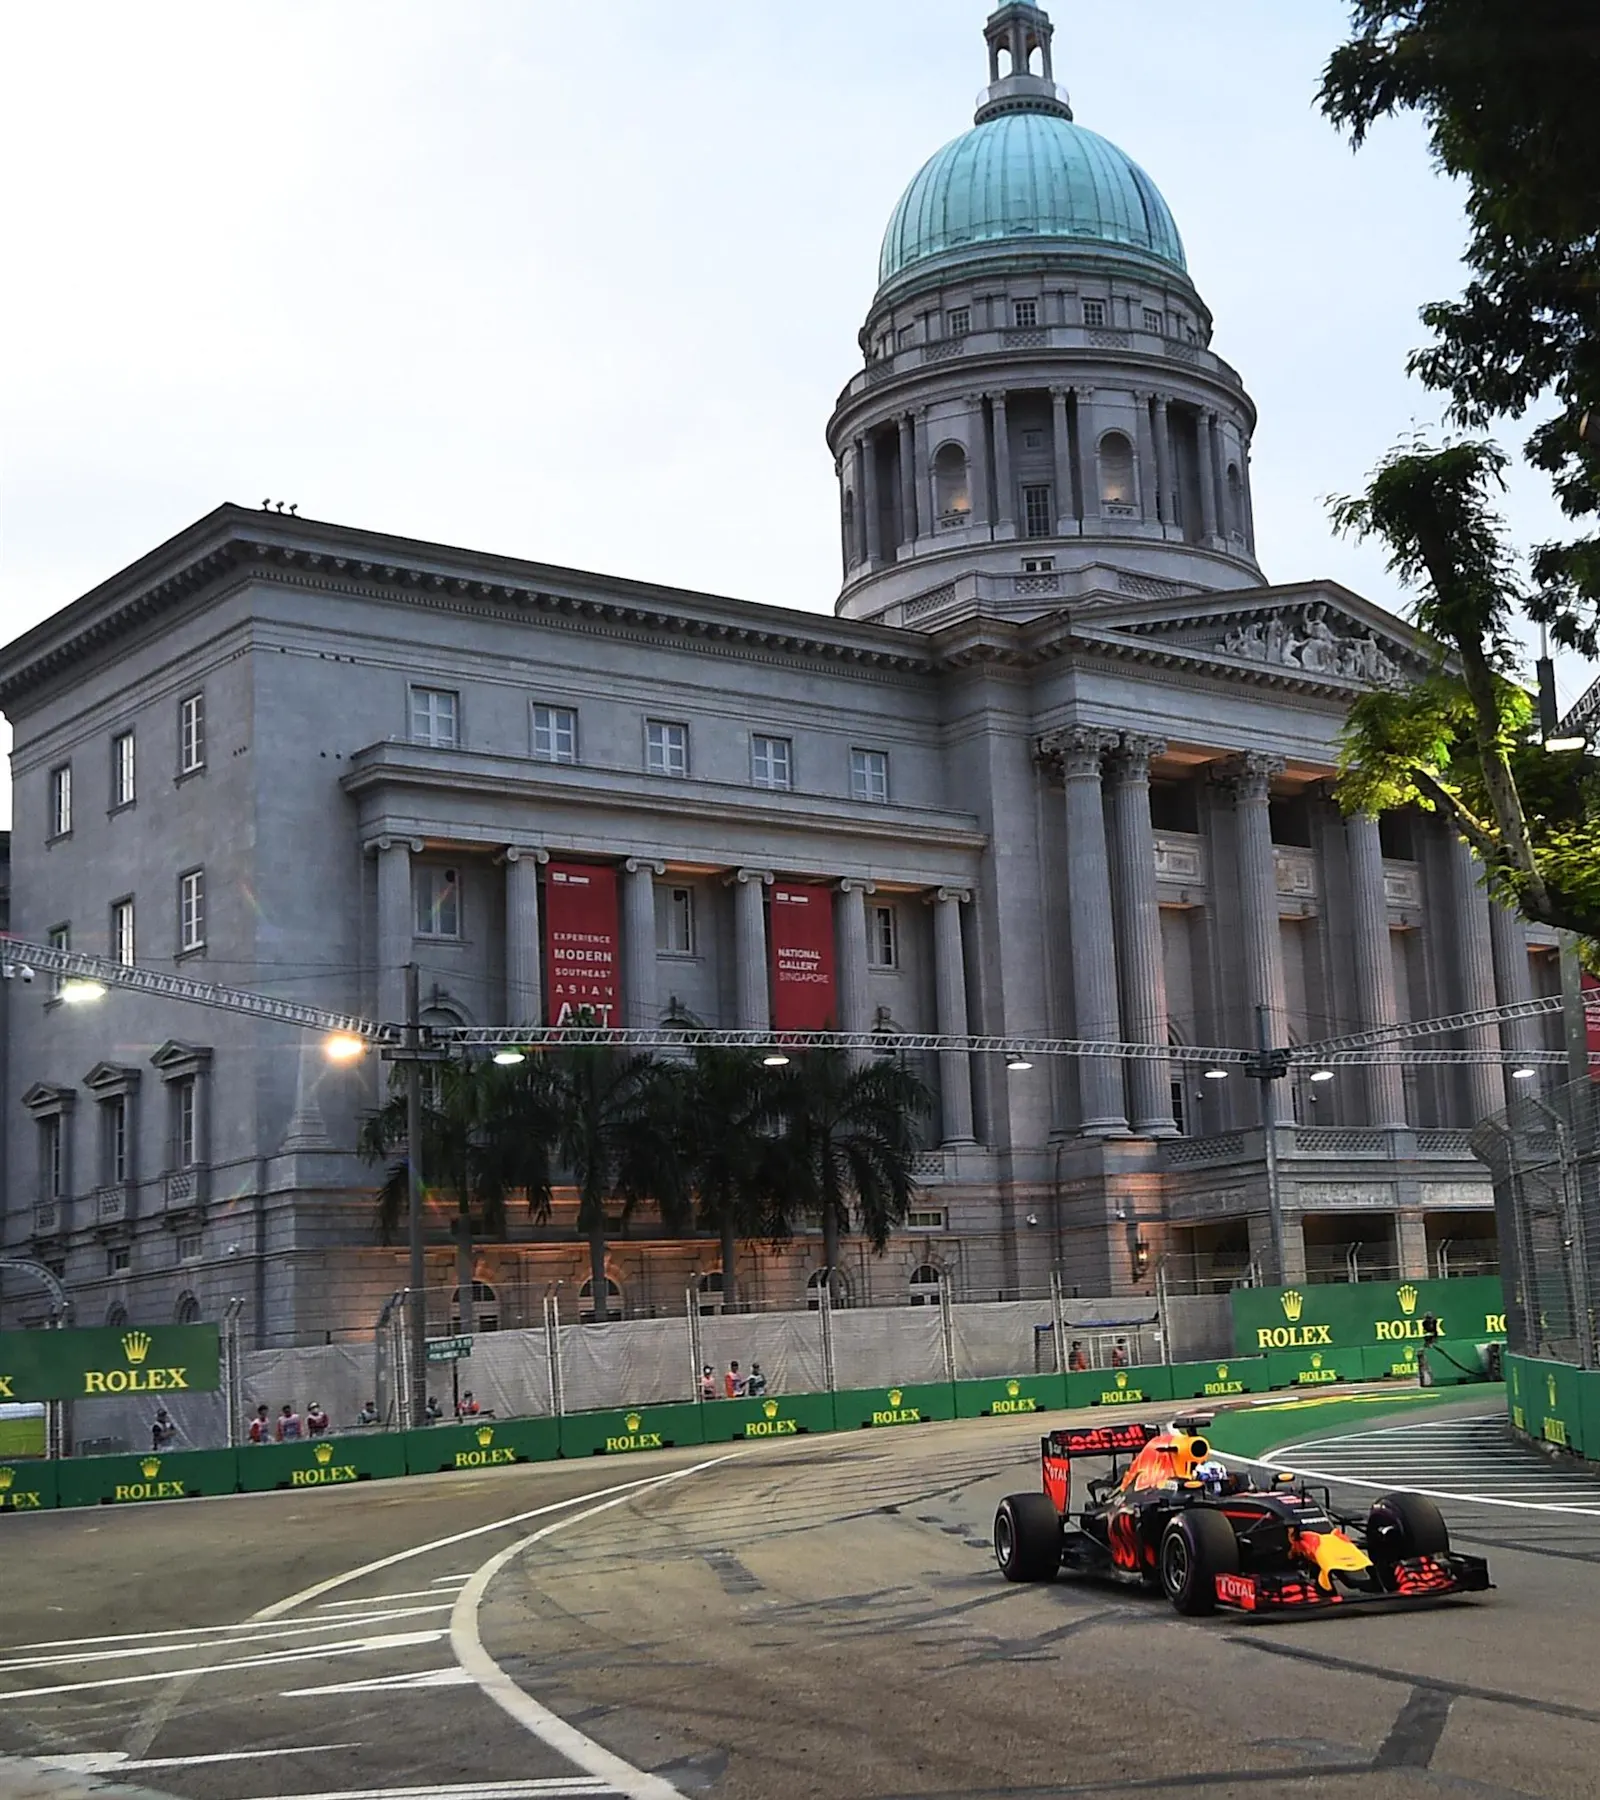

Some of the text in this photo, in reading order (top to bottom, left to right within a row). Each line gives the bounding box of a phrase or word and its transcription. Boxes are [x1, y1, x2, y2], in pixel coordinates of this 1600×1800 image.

[553, 932, 611, 944] EXPERIENCE
[553, 948, 612, 962] MODERN
[778, 948, 821, 959] NATIONAL
[554, 967, 612, 978] SOUTHEAST
[778, 960, 818, 971] GALLERY
[779, 972, 829, 983] SINGAPORE
[555, 984, 613, 997] ASIAN
[1257, 1325, 1333, 1348] ROLEX
[84, 1367, 189, 1393] ROLEX
[1299, 1369, 1337, 1384] ROLEX
[1204, 1380, 1243, 1394] ROLEX
[1102, 1389, 1143, 1405] ROLEX
[992, 1398, 1037, 1414] ROLEX
[872, 1408, 921, 1425] ROLEX
[746, 1418, 798, 1436] ROLEX
[606, 1432, 663, 1451] ROLEX
[455, 1446, 517, 1467] ROLEX
[292, 1465, 357, 1486] ROLEX
[115, 1481, 185, 1500] ROLEX
[0, 1492, 41, 1508] LEX
[1220, 1578, 1256, 1600] TOTAL
